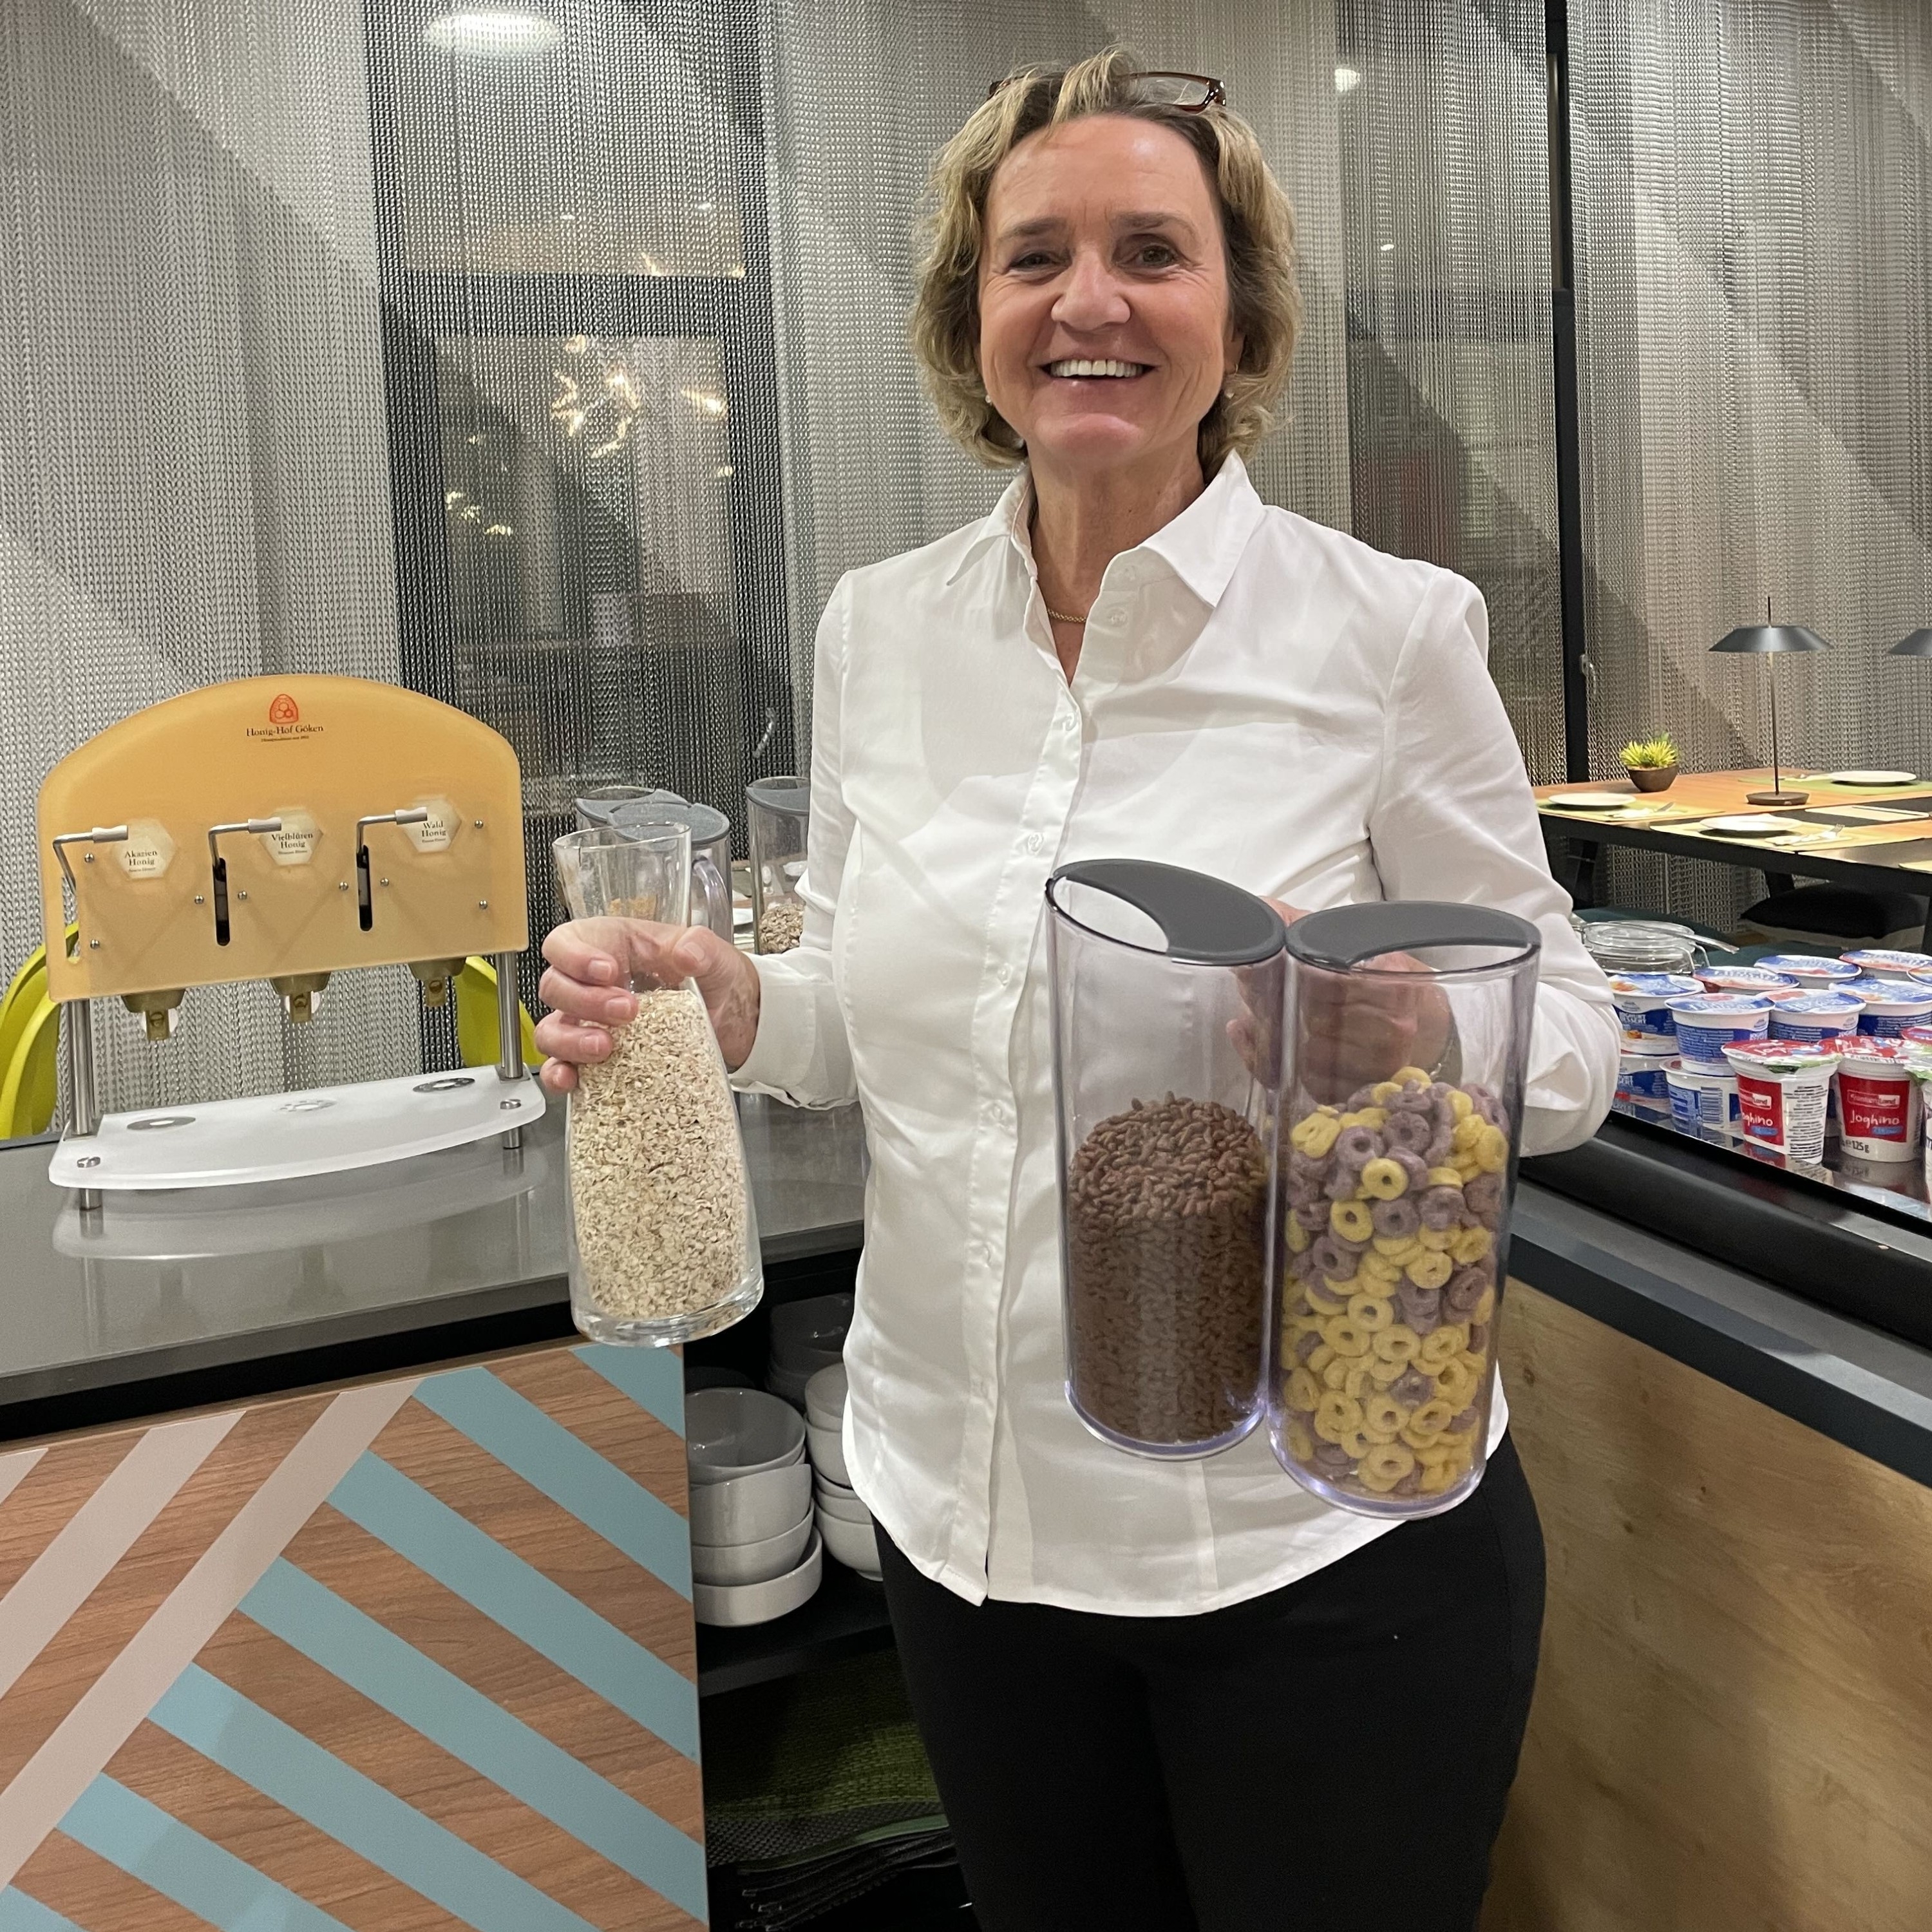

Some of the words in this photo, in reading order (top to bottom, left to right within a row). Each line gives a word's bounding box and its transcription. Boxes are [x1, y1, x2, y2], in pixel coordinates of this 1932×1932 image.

[247, 725, 292, 737] Honig-Hof
[295, 724, 324, 734] Göken
[423, 820, 444, 829] Wald
[422, 829, 446, 837] Honig
[124, 849, 158, 858] Akazien
[129, 858, 155, 866] Honig
[1850, 1109, 1900, 1129] Joghino
